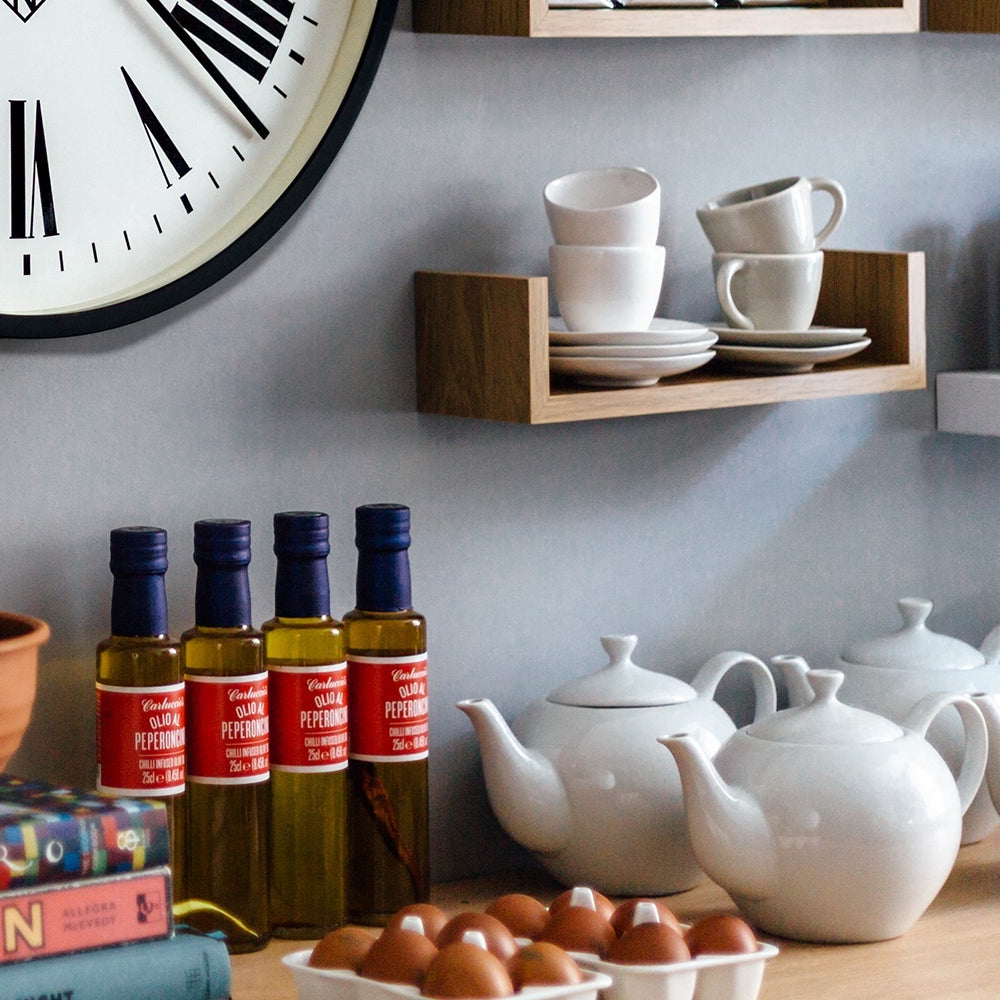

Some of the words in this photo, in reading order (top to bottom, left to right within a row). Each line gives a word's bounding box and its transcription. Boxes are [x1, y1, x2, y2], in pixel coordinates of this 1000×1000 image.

[399, 682, 419, 699] OLIO
[419, 682, 427, 696] AL
[314, 691, 335, 708] OLIO
[336, 691, 344, 705] AL
[235, 701, 256, 719] OLIO
[257, 701, 265, 715] AL
[149, 712, 172, 729] OLIO
[172, 713, 180, 727] AL
[62, 901, 117, 918] ALLEGRA
[63, 916, 117, 933] McEVEDY
